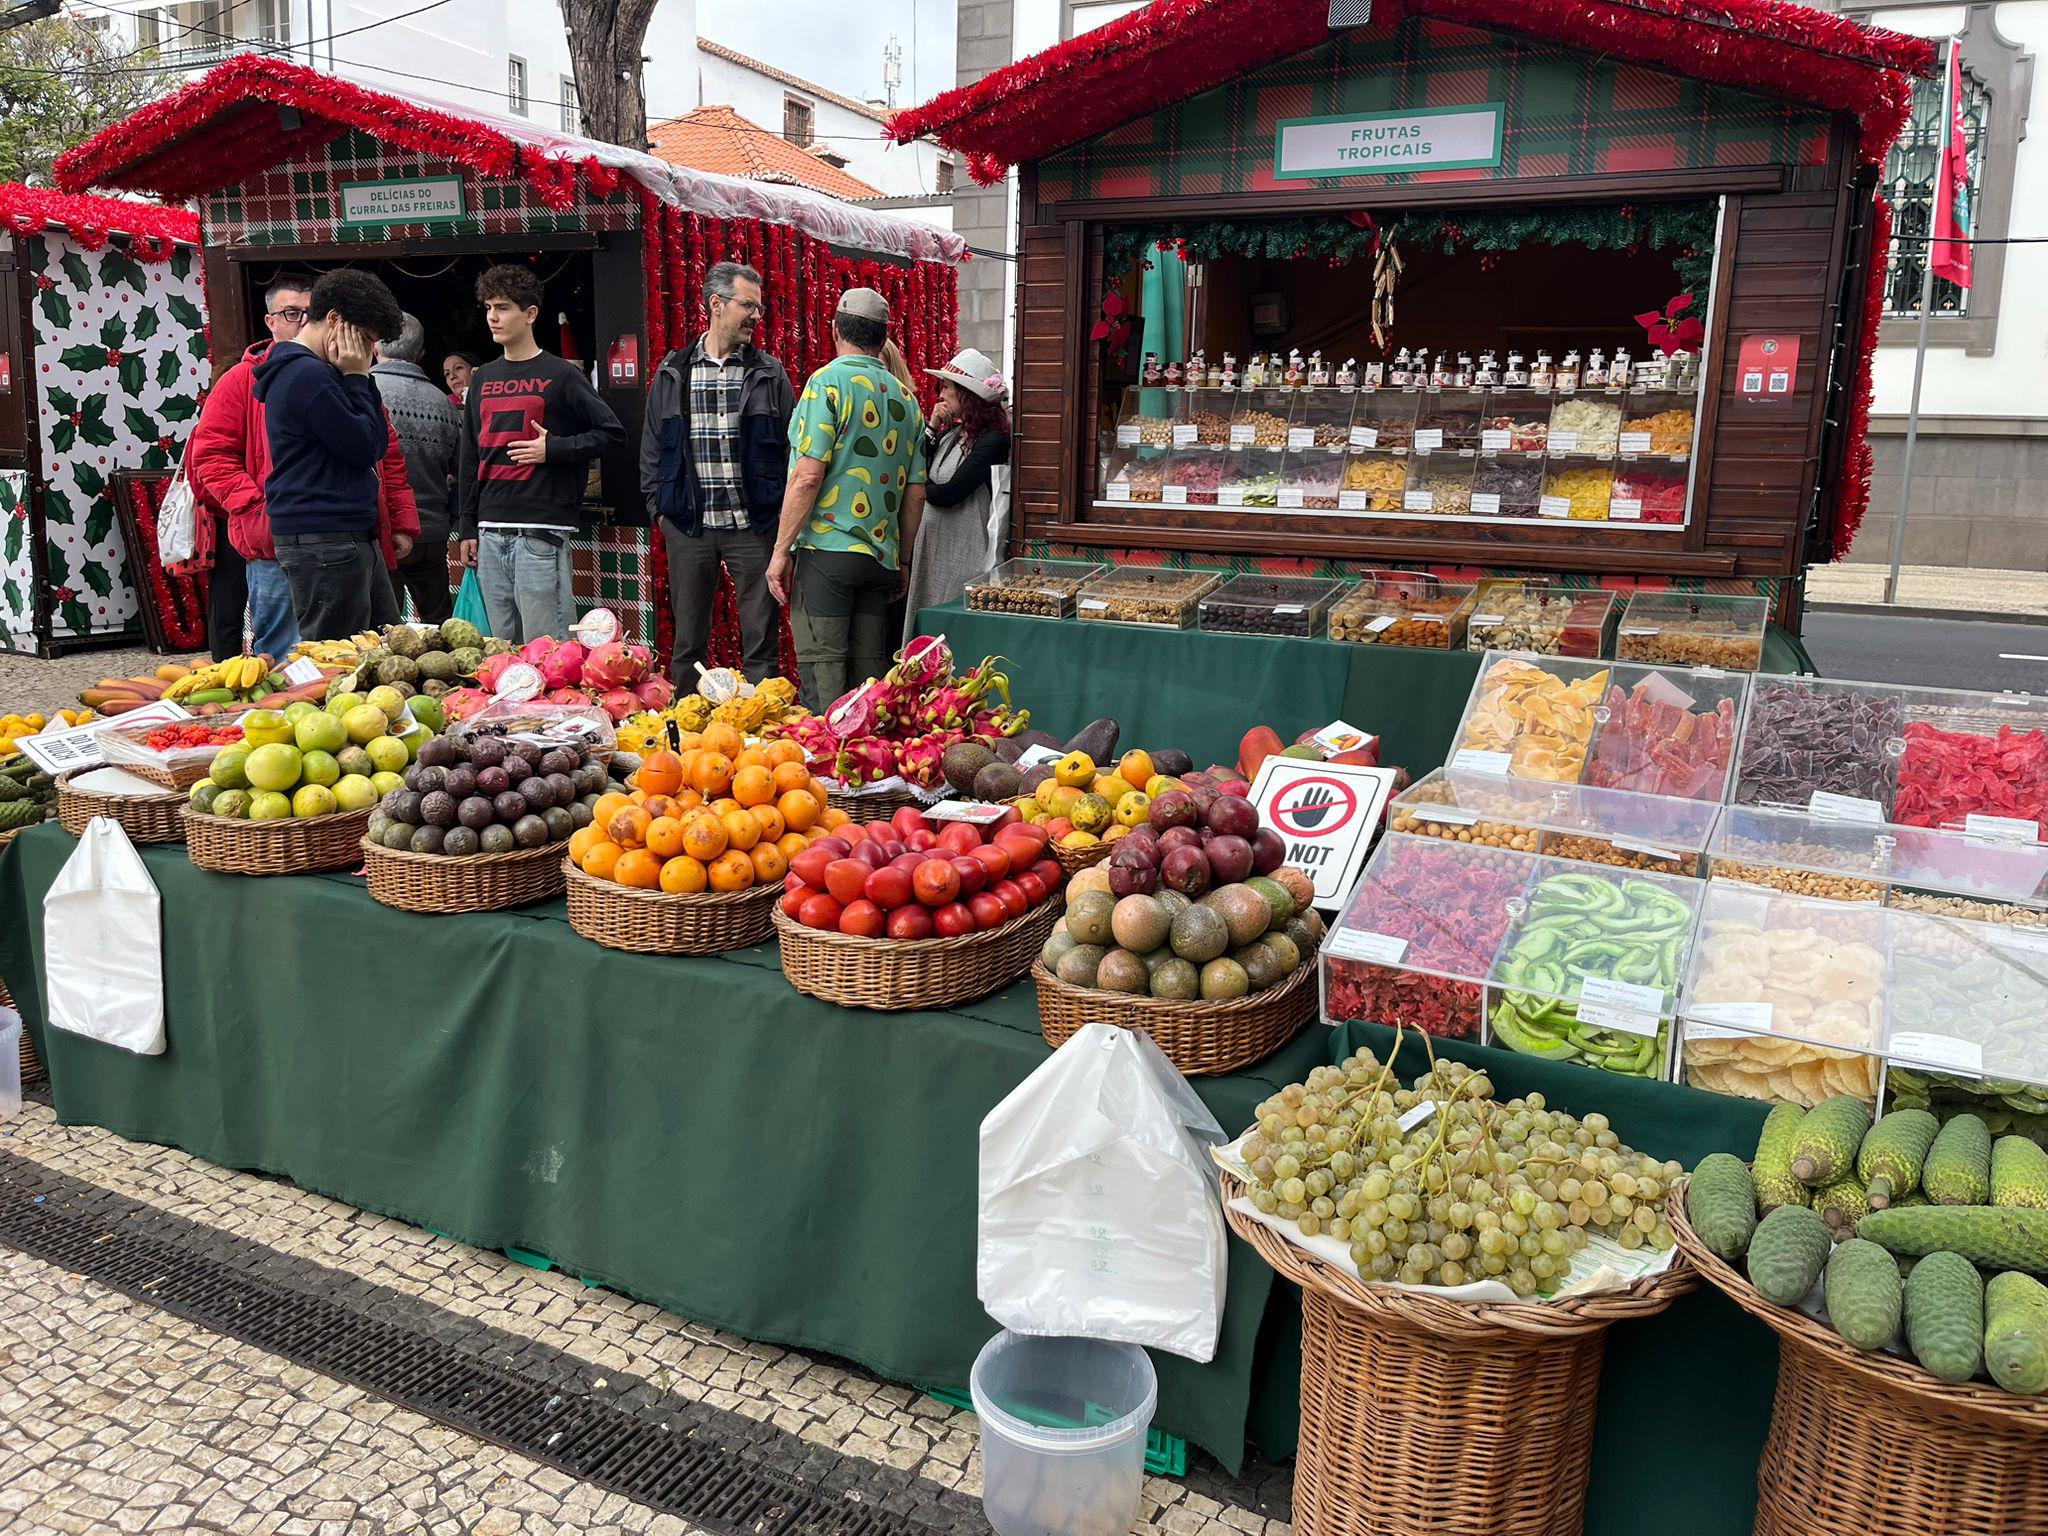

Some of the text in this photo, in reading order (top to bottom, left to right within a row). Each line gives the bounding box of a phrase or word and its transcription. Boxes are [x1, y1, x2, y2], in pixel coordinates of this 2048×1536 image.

[1351, 125, 1421, 142] FRUTAS
[1338, 142, 1432, 160] TROPICAIS
[370, 188, 432, 201] DELÍCIAS DO
[350, 200, 456, 215] CURRAL DAS FREIRAS
[480, 378, 553, 396] EBONY
[40, 739, 79, 761] TOUCH
[1287, 843, 1334, 866] NOT
